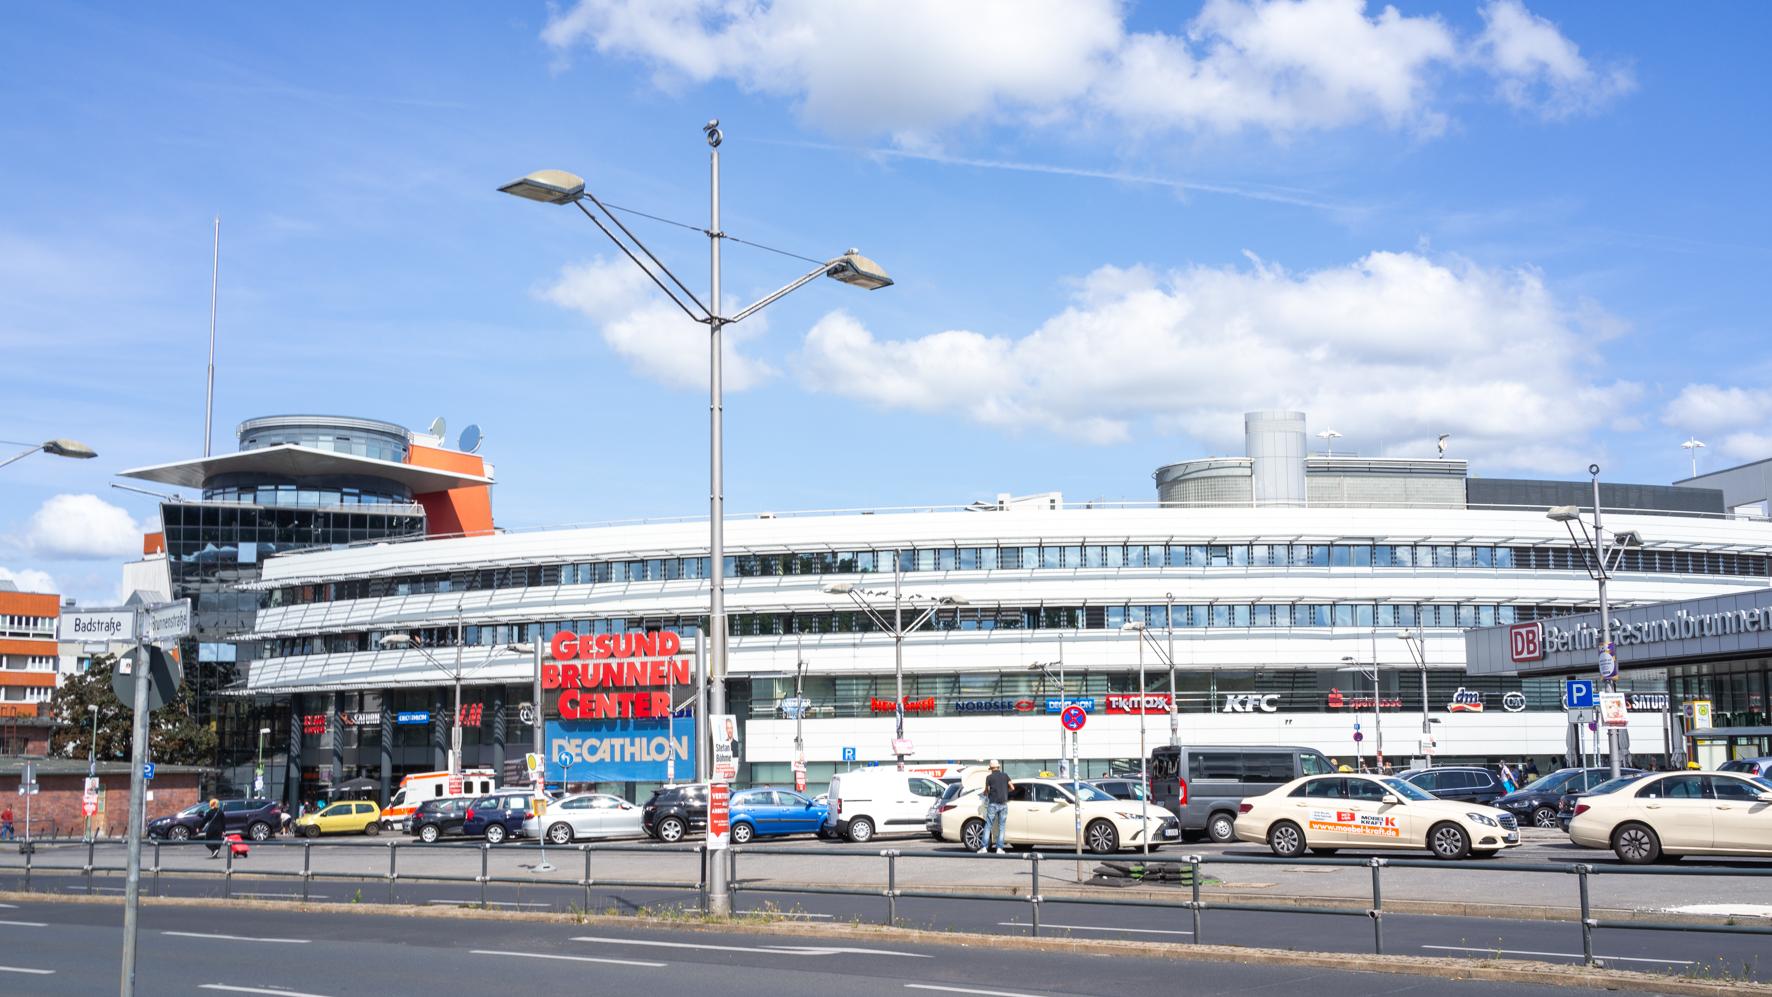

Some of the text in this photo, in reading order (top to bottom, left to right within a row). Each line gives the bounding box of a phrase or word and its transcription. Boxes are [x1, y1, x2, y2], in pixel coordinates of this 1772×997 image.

[74, 617, 122, 636] Badstraße
[551, 630, 680, 661] GESUND
[1513, 629, 1538, 657] DB
[541, 659, 691, 689] BRUNNEN
[557, 688, 671, 720] CENTER
[1222, 694, 1281, 713] KFC
[1455, 689, 1478, 704] dm
[1573, 684, 1587, 705] P
[955, 700, 1014, 712] NORDSEE
[551, 736, 689, 763] DECATHLON
[1312, 822, 1396, 837] www.moebel-kraft.de
